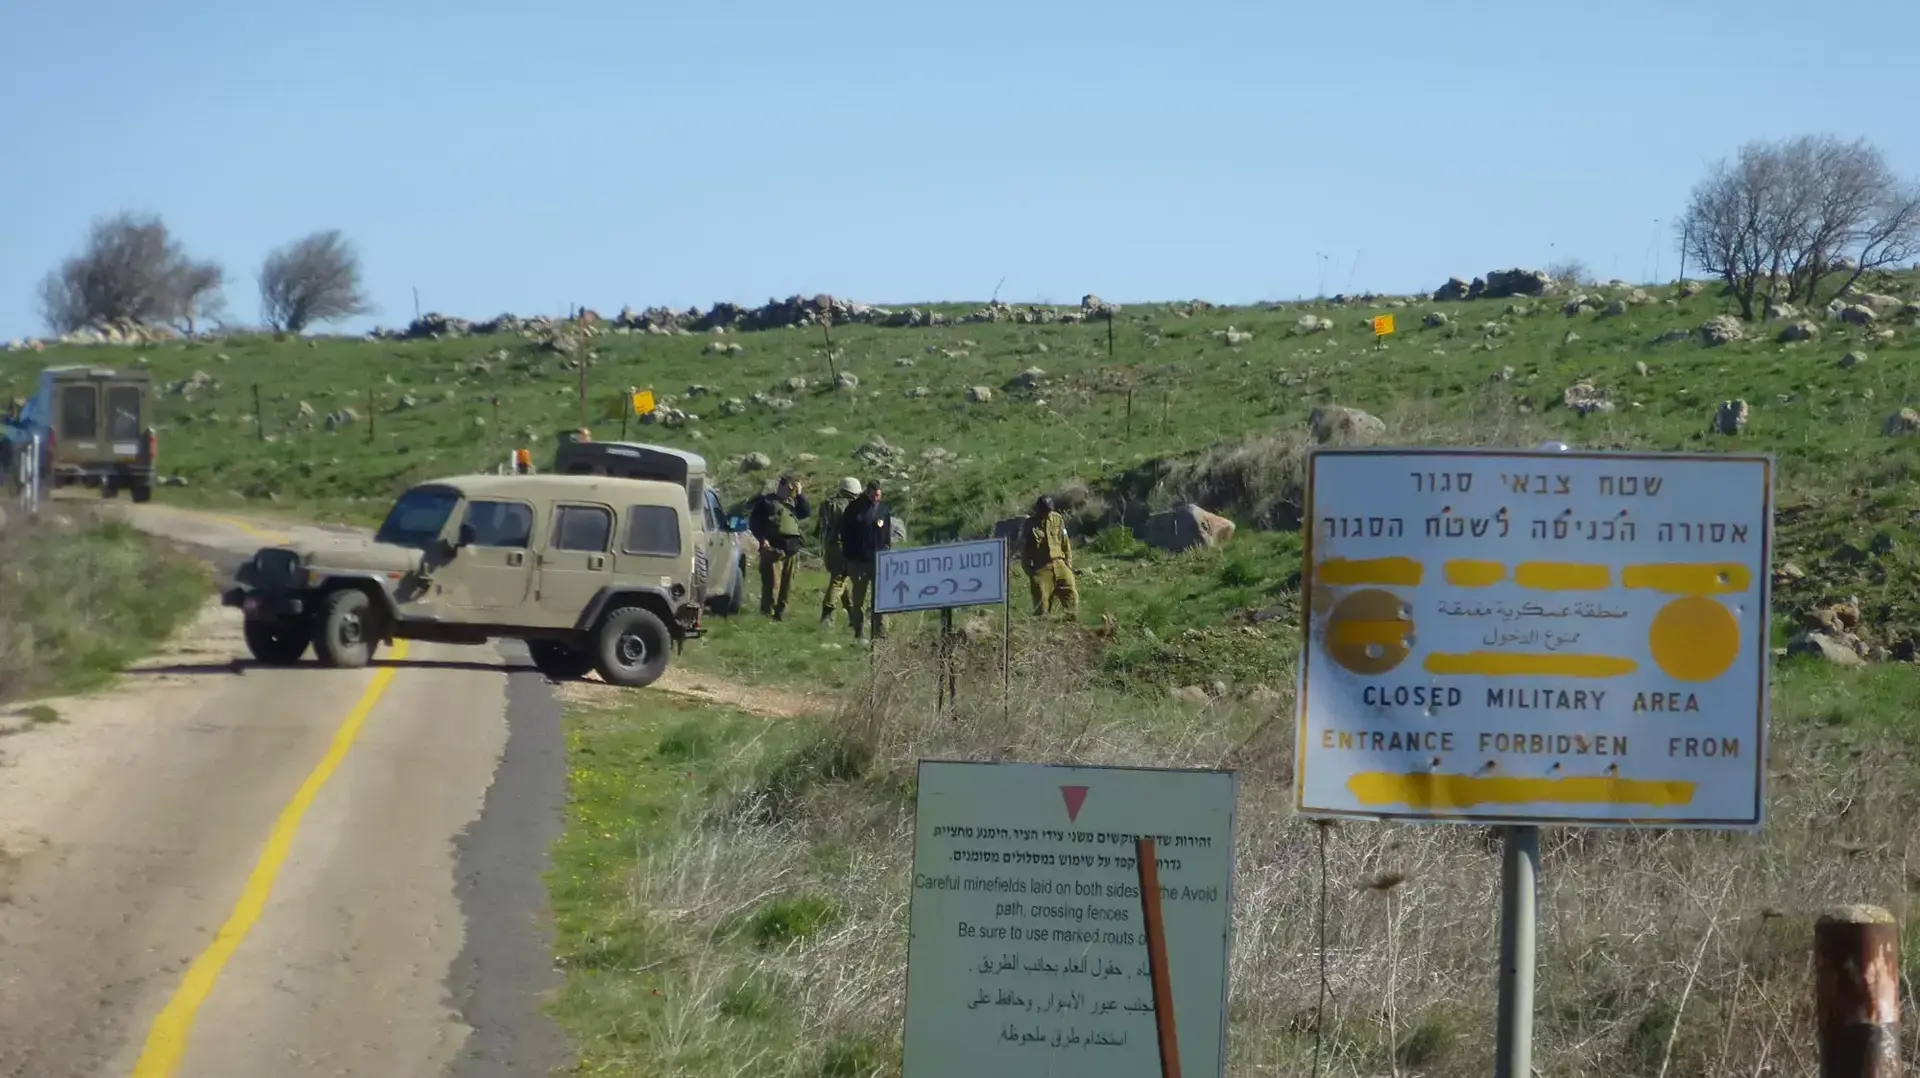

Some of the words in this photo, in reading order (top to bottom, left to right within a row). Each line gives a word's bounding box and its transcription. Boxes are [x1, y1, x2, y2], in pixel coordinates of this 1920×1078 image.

[1410, 471, 1473, 493] סגור
[1501, 473, 1571, 494] צבאי
[1600, 474, 1663, 495] שטח
[1324, 516, 1404, 538] הסגור
[1425, 511, 1508, 538] לשטח
[1531, 519, 1636, 542] הכניסה
[1658, 521, 1748, 544] אסורה
[916, 556, 953, 574] מרום
[960, 552, 993, 570] מטע
[1496, 600, 1570, 621] عسكرية
[1574, 601, 1628, 618] منطقة
[1482, 627, 1539, 647] الدخول
[1363, 686, 1462, 708] CLOSED
[1486, 688, 1606, 711] MILITARY
[1632, 692, 1700, 713] AREA
[1322, 729, 1454, 752] ENTRANCE
[1669, 737, 1739, 758] FROM
[1042, 829, 1064, 842] צידי
[1068, 830, 1094, 843] משני
[1175, 835, 1212, 848] זהירות
[1002, 850, 1055, 866] במסלולים
[1059, 853, 1095, 868] שימוש
[1098, 853, 1111, 868] על
[1114, 855, 1138, 871] קפד
[1155, 857, 1182, 871] גדרו
[915, 872, 960, 890] Careful
[964, 875, 1026, 893] minefields
[1030, 877, 1052, 894] laid
[1056, 883, 1071, 895] on
[1075, 880, 1102, 897] both
[1106, 882, 1139, 898] sides
[1181, 885, 1218, 902] Avoid
[1031, 903, 1083, 922] crossing
[1087, 904, 1129, 921] fences
[958, 921, 975, 938] Be
[979, 925, 1006, 939] sure
[1010, 924, 1022, 940] to
[1026, 928, 1049, 941] use
[1053, 927, 1100, 944] marked
[1102, 930, 1135, 946] routs
